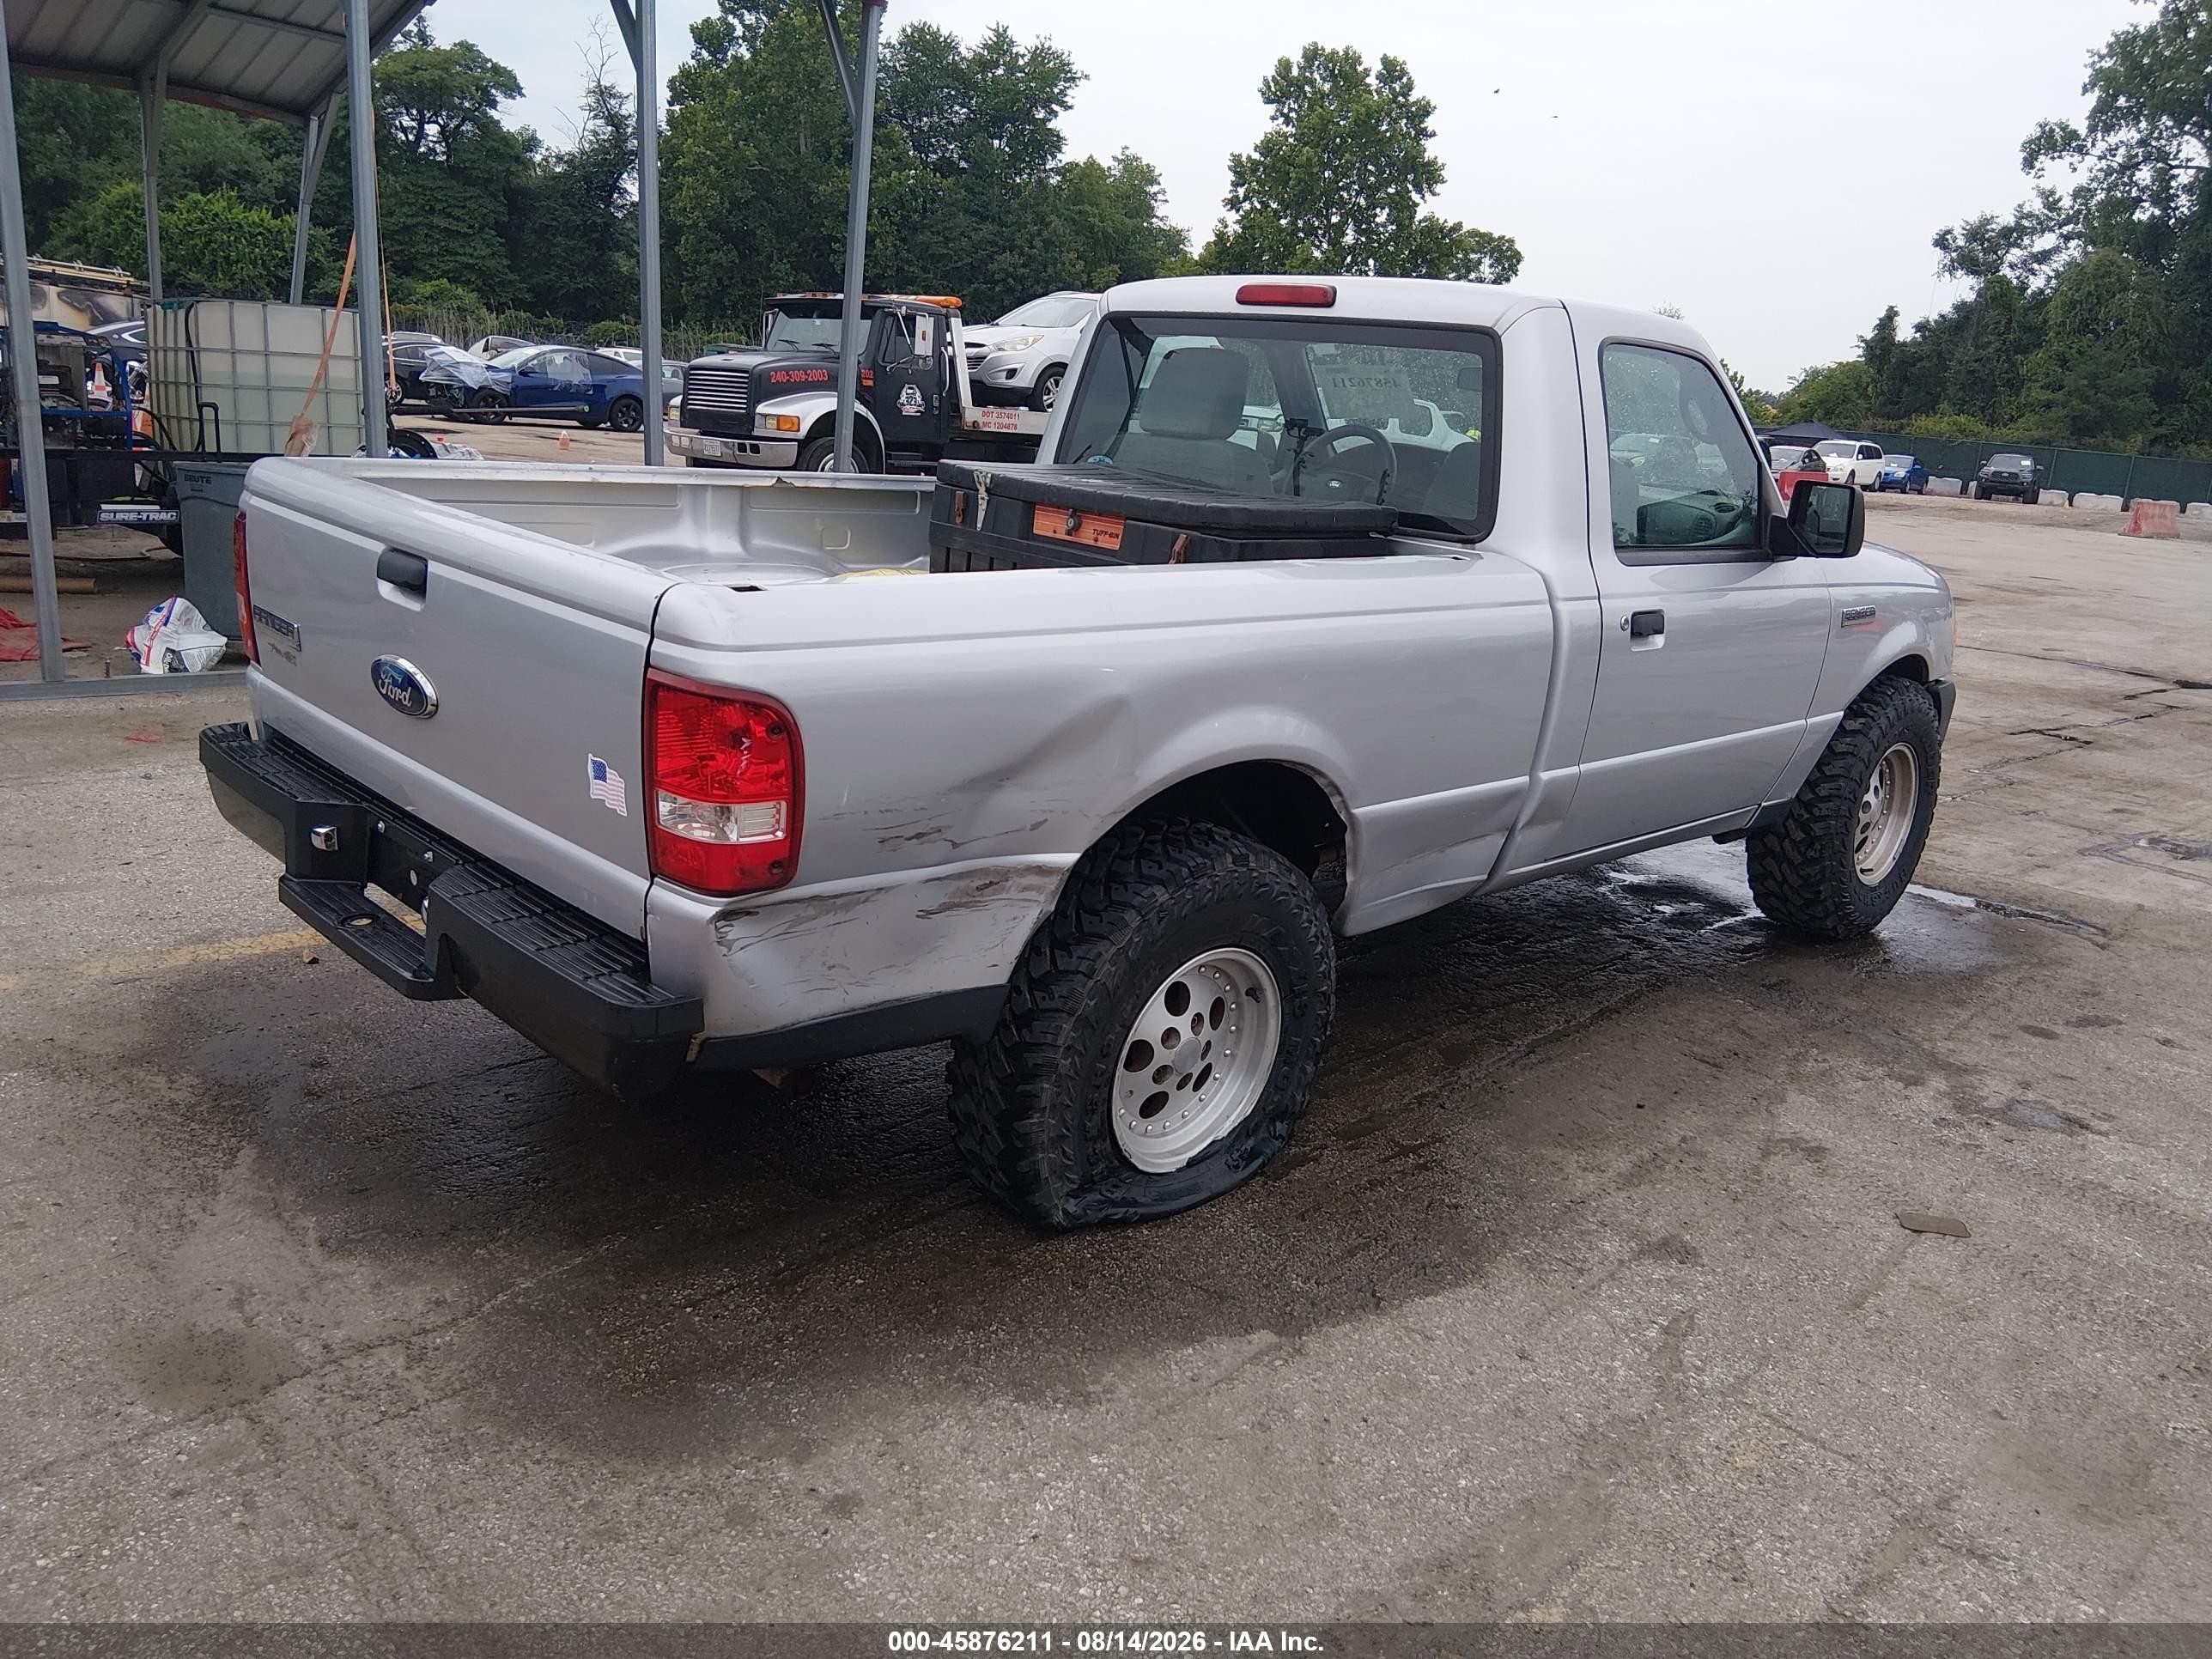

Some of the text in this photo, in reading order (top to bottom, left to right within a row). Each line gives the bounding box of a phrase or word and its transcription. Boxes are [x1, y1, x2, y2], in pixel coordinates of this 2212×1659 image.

[769, 369, 829, 383] 240-309-2003
[185, 473, 211, 484] BRUTE
[100, 512, 177, 521] SURE-TRAC
[378, 665, 412, 708] Ford
